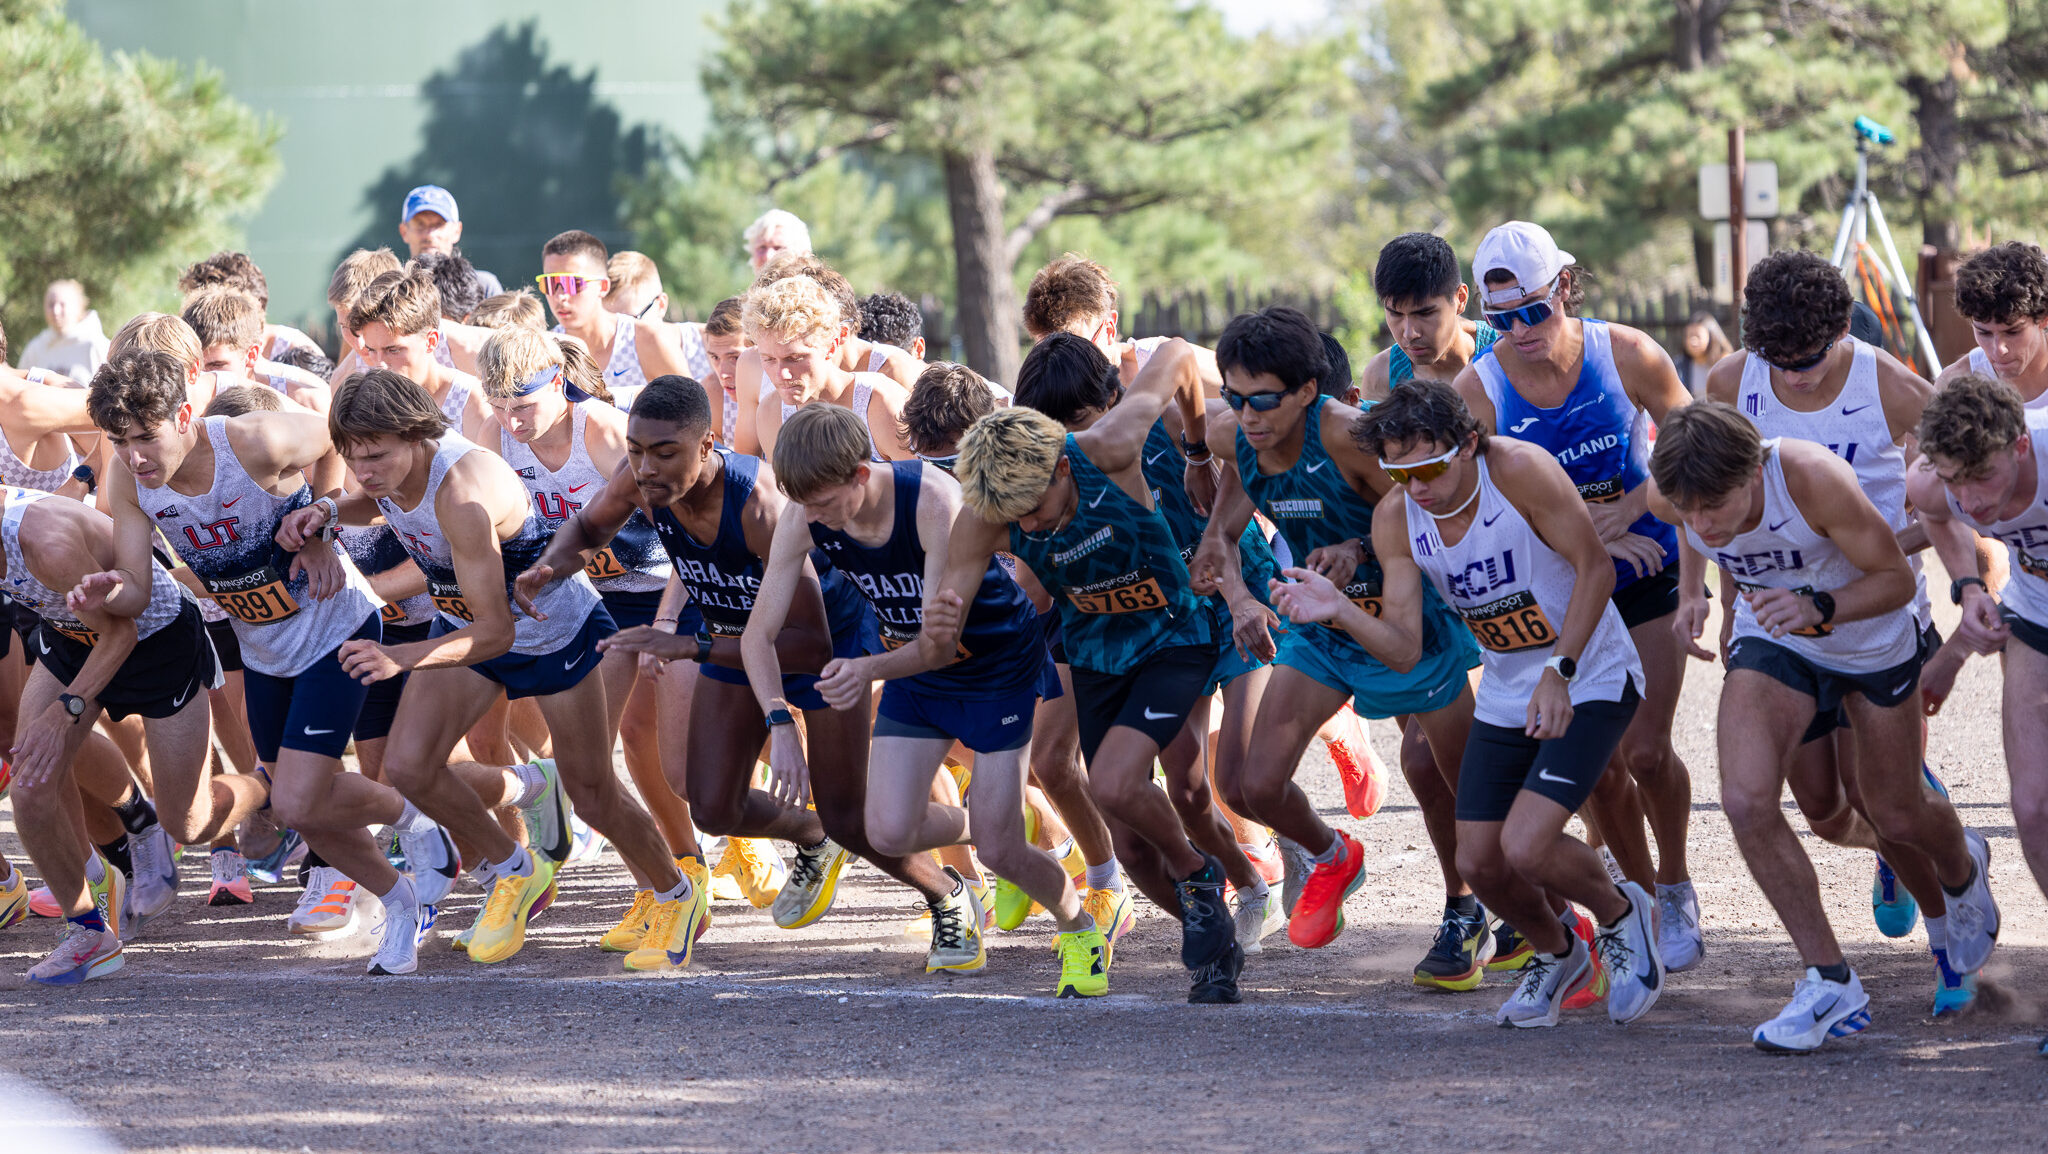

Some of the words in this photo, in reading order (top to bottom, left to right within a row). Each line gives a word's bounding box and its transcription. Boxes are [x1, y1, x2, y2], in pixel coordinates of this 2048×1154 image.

[1555, 434, 1618, 465] TLAND
[1576, 481, 1613, 494] GFOOT
[183, 516, 242, 550] UT
[1992, 525, 2048, 549] GC
[1447, 549, 1516, 600] GCU
[1717, 550, 1804, 576] GCU
[218, 569, 266, 588] WINGFOOT
[439, 584, 461, 592] WING
[1083, 570, 1140, 591] WINGFOOT
[214, 585, 290, 620] 5891
[686, 585, 754, 611] VALLE
[1074, 583, 1159, 612] 5763
[1469, 594, 1522, 617] WINGFOOT
[435, 598, 474, 623] 58
[722, 624, 745, 633] WING
[1468, 609, 1549, 648] 5816
